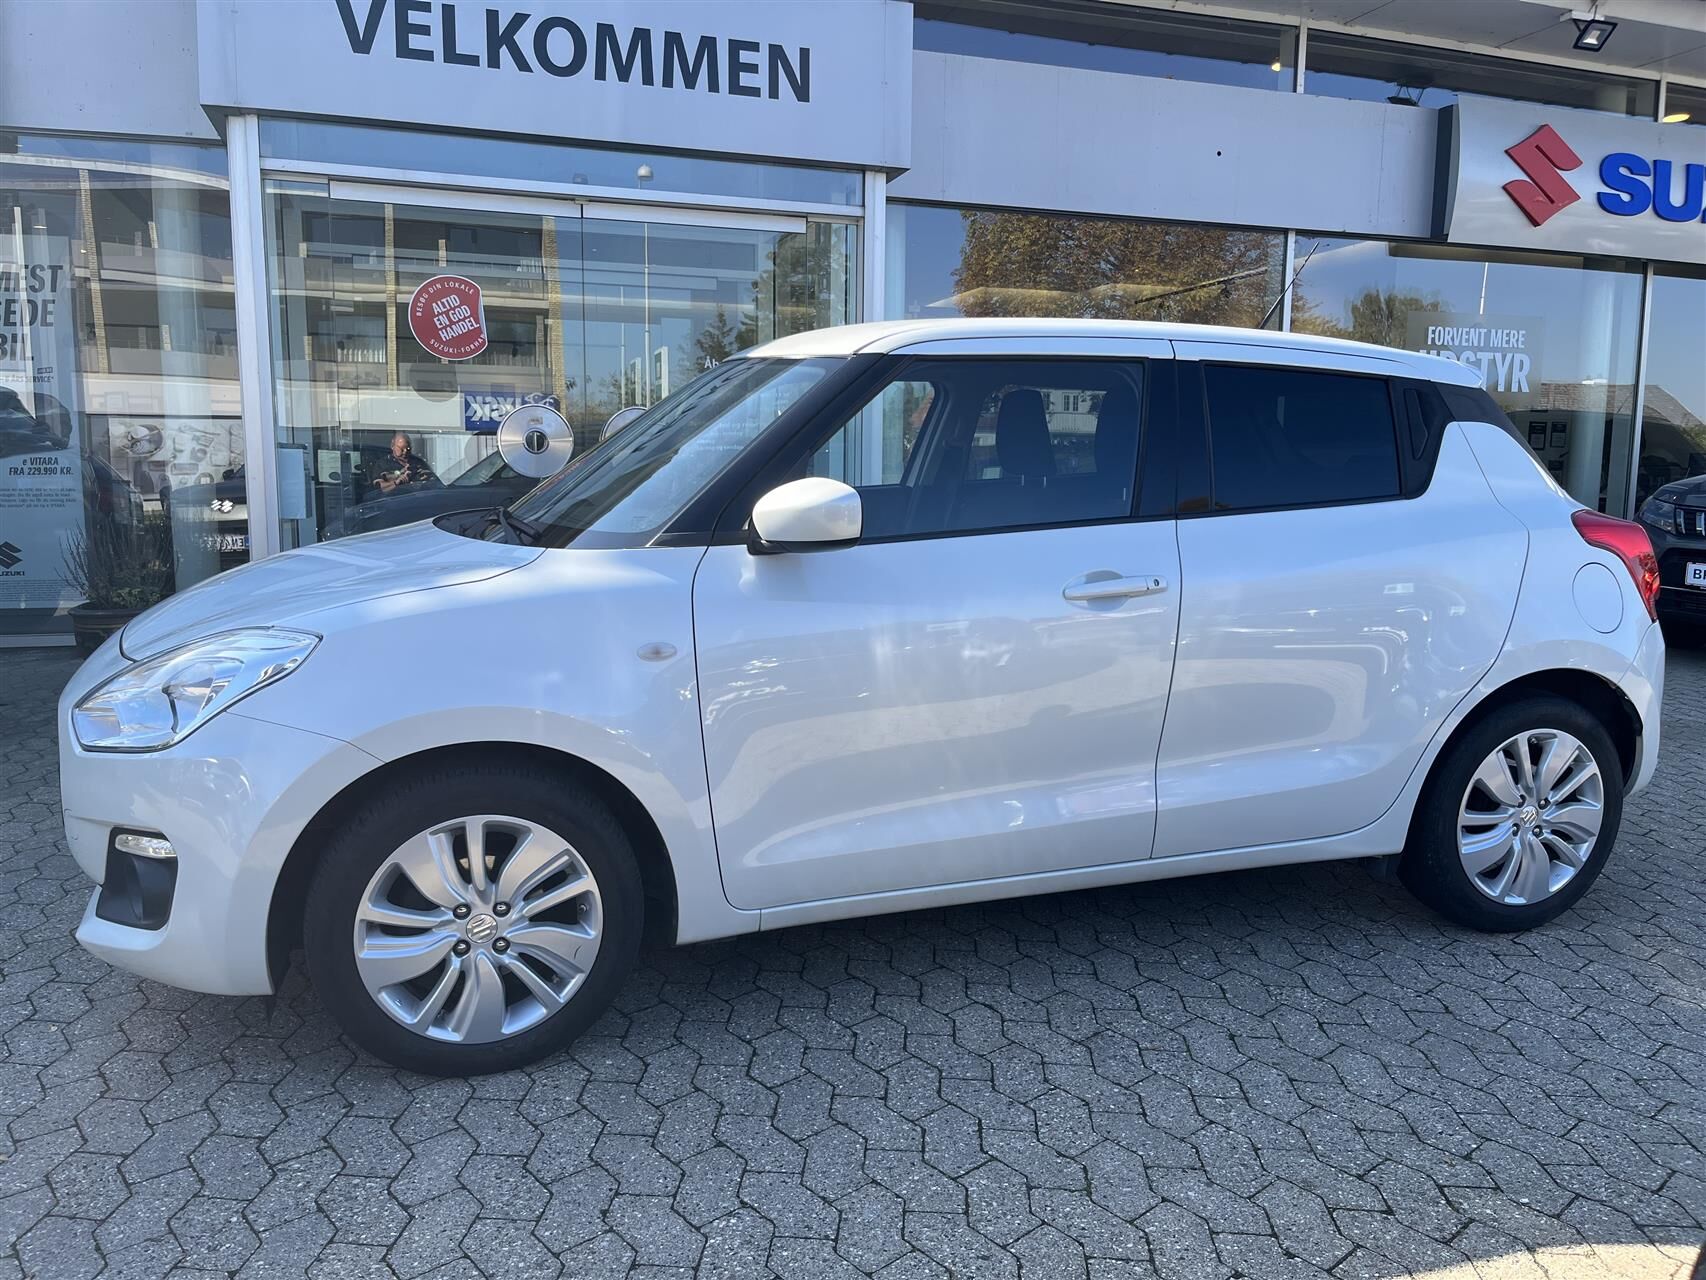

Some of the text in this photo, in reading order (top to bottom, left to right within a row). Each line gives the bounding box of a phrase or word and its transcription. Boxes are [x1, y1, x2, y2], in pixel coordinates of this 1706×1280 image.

[335, 0, 811, 103] VELKOMMEN
[1597, 152, 1706, 224] SU
[416, 281, 474, 316] BESØG DIN LOKALE
[432, 294, 460, 315] ALTID
[0, 298, 55, 327] EDE
[433, 305, 471, 329] EN GOD
[438, 316, 480, 342] HANDEL
[1427, 326, 1526, 349] FORVENT MERE
[9, 466, 74, 476] FRA 229.990 KR.
[22, 456, 59, 466] e VITARA
